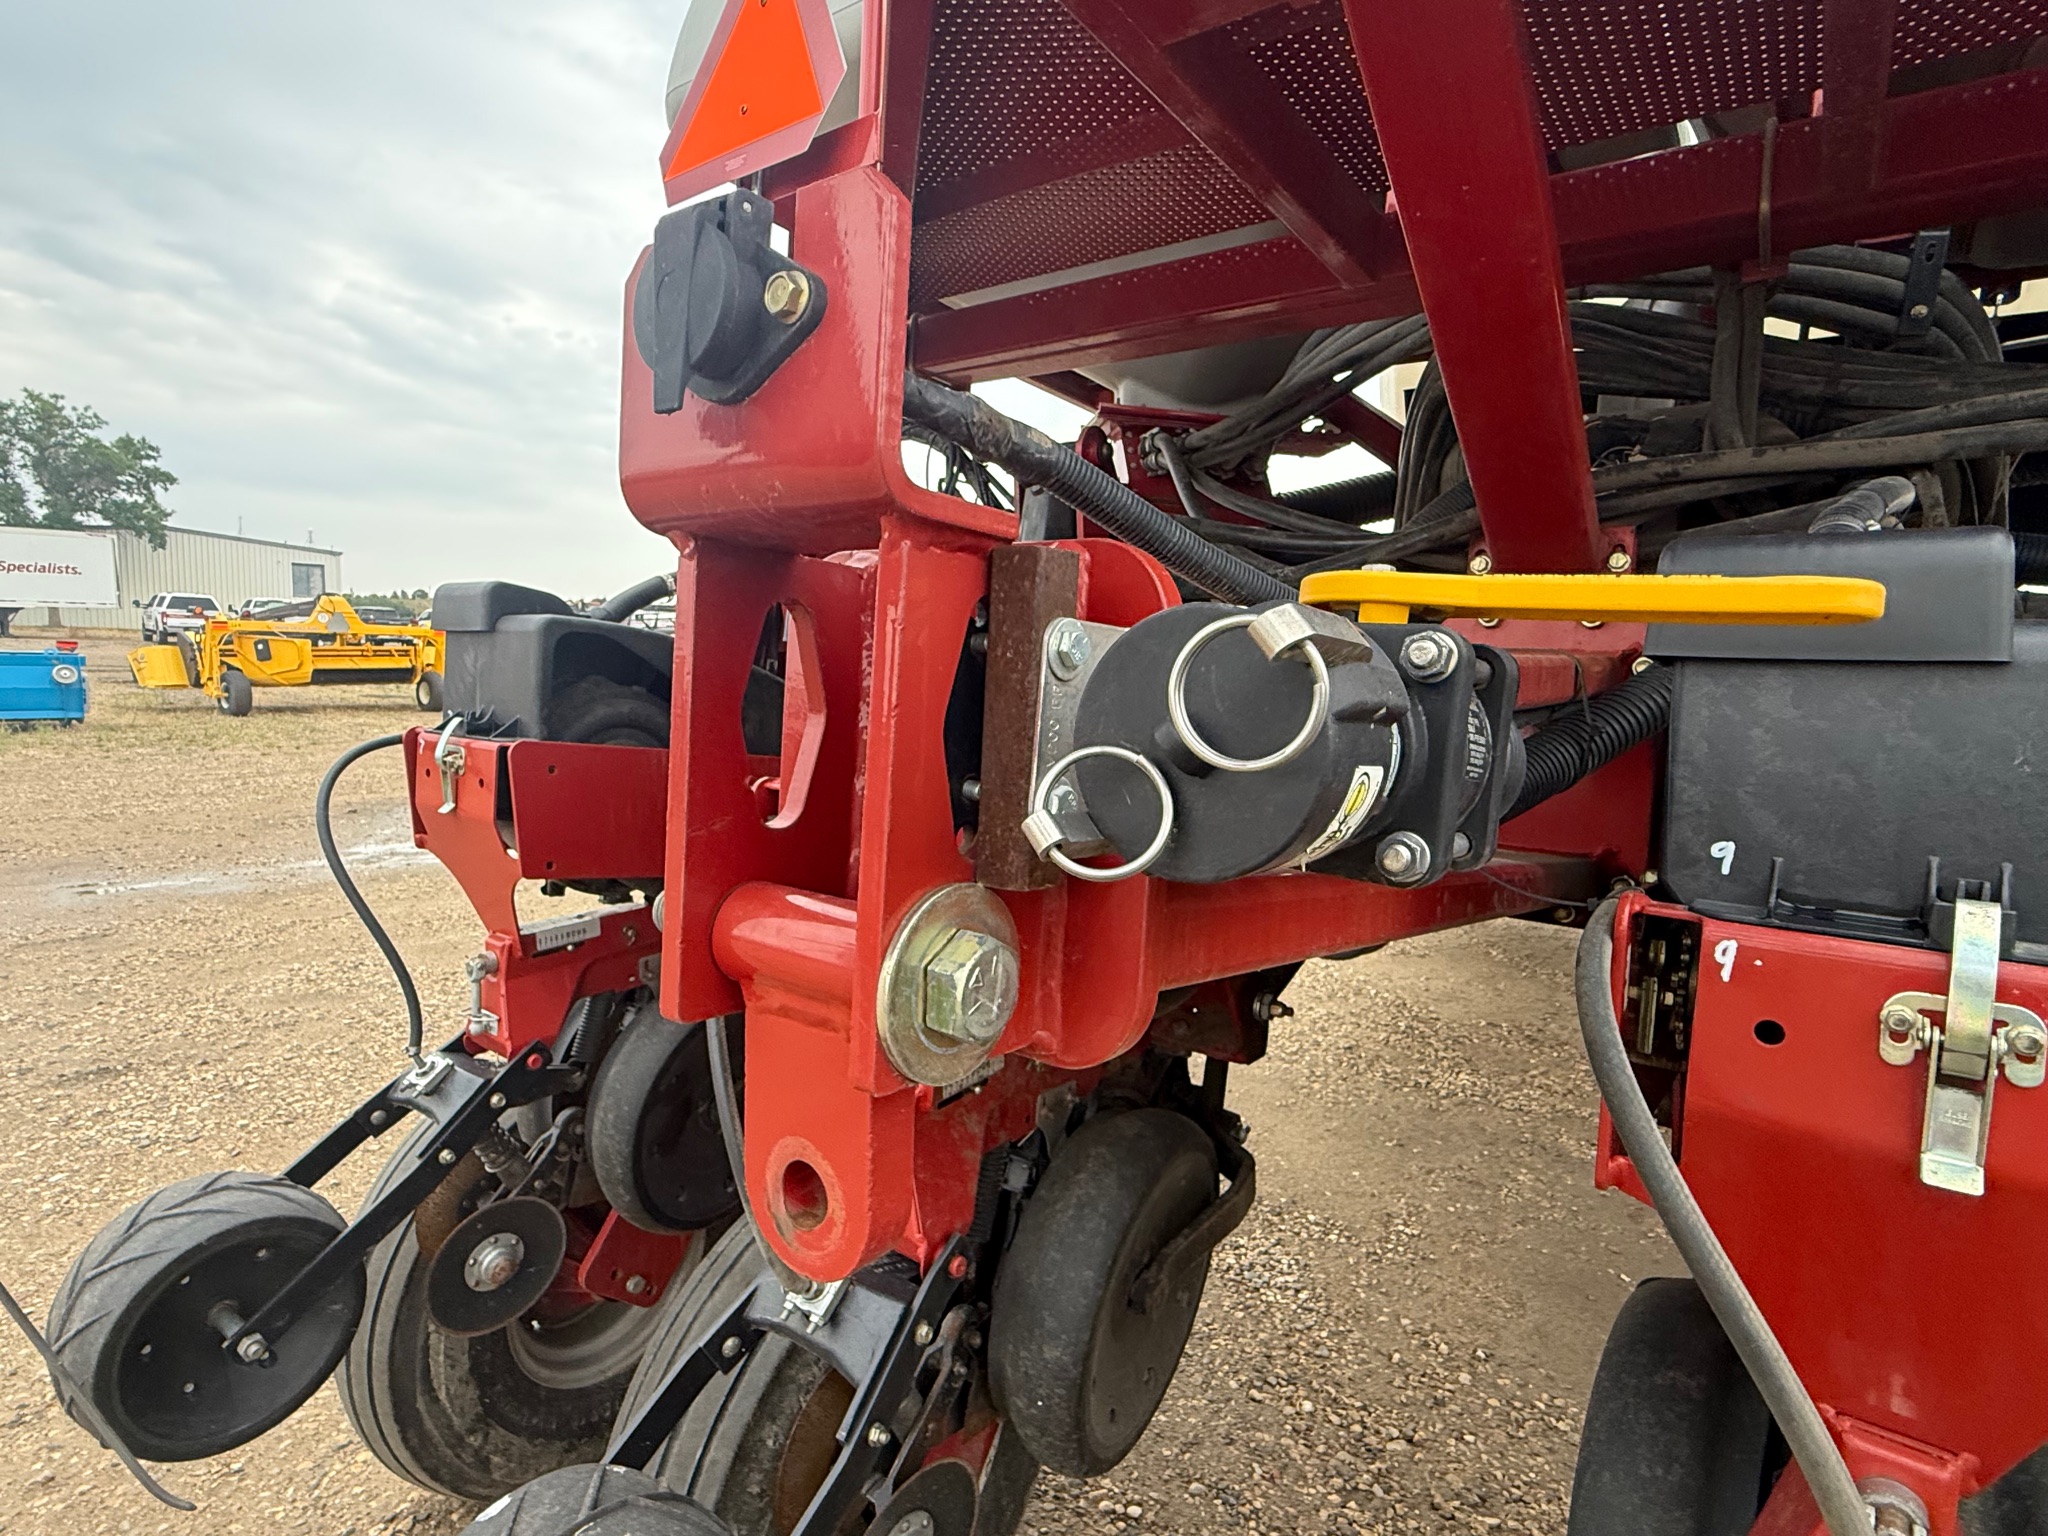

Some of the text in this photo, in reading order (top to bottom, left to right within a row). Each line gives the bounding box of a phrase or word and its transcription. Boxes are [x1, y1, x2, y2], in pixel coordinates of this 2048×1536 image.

[0, 560, 82, 576] Specialists.
[1710, 840, 1736, 875] 9
[1714, 939, 1738, 983] 9
